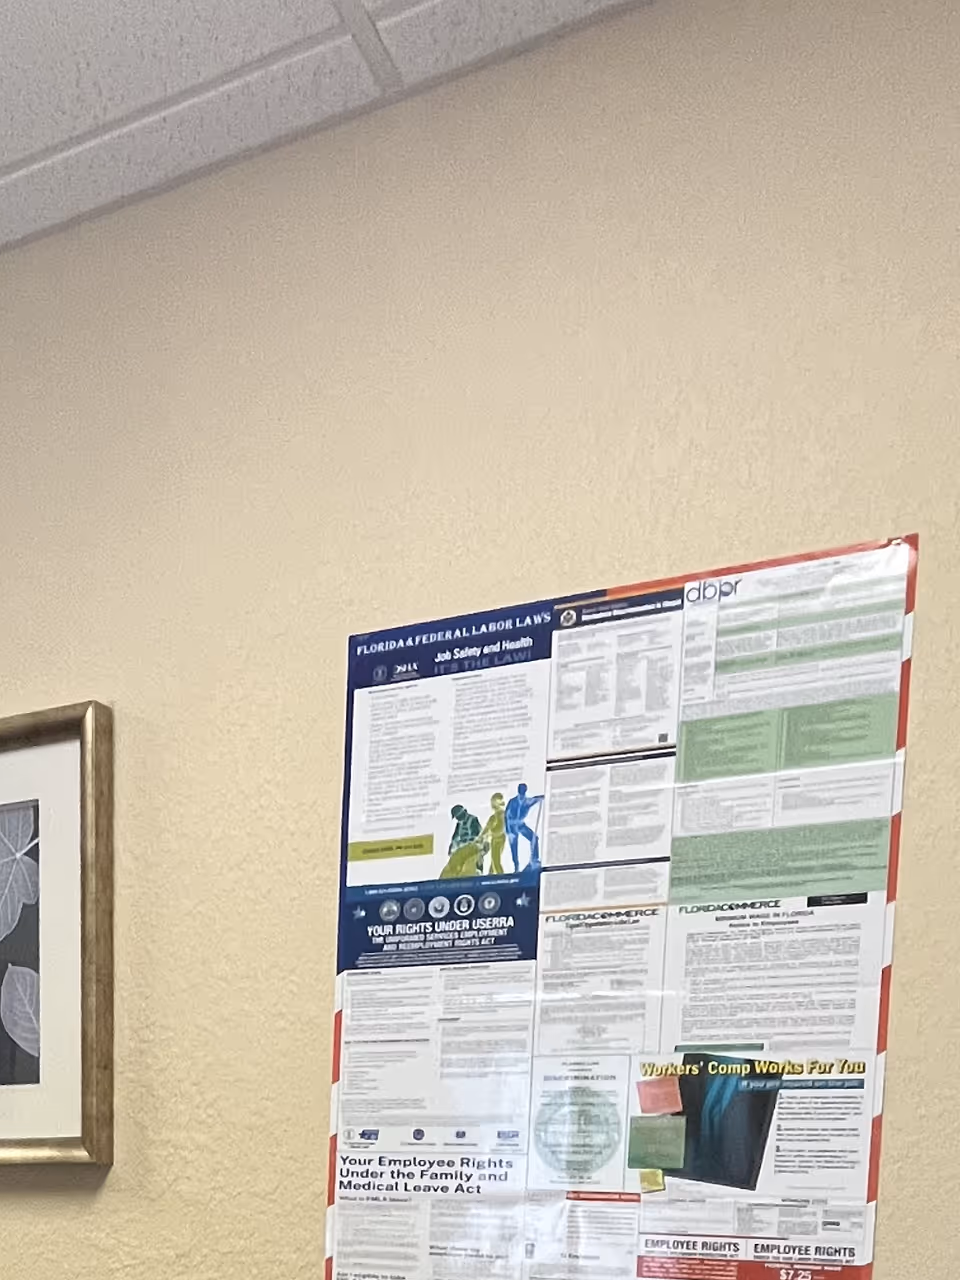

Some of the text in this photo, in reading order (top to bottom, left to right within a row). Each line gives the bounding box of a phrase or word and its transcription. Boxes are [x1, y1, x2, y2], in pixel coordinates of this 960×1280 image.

[686, 579, 742, 603] dbpr
[357, 639, 404, 655] FLORIDA
[415, 628, 470, 645] FEDERAL
[472, 619, 513, 635] LABOR
[516, 612, 551, 628] LAWS
[435, 636, 533, 662] Job Safety and Health
[464, 656, 491, 669] THE
[495, 650, 531, 664] LAW!
[679, 899, 781, 914] FLORIDACOMMERCE
[546, 908, 659, 923] FLORIDACOMMERCE
[367, 917, 514, 936] YOUR RIGHTS UNDER USERRA
[639, 1058, 866, 1078] Workers' Comp Works For You
[340, 1155, 513, 1171] Your Employee Rights
[340, 1168, 508, 1183] Under the Family and
[339, 1180, 481, 1194] Medical Leave Act
[644, 1238, 740, 1252] EMPLOYEE RIGHTS
[754, 1243, 856, 1258] EMPLOYEE RIGHTS
